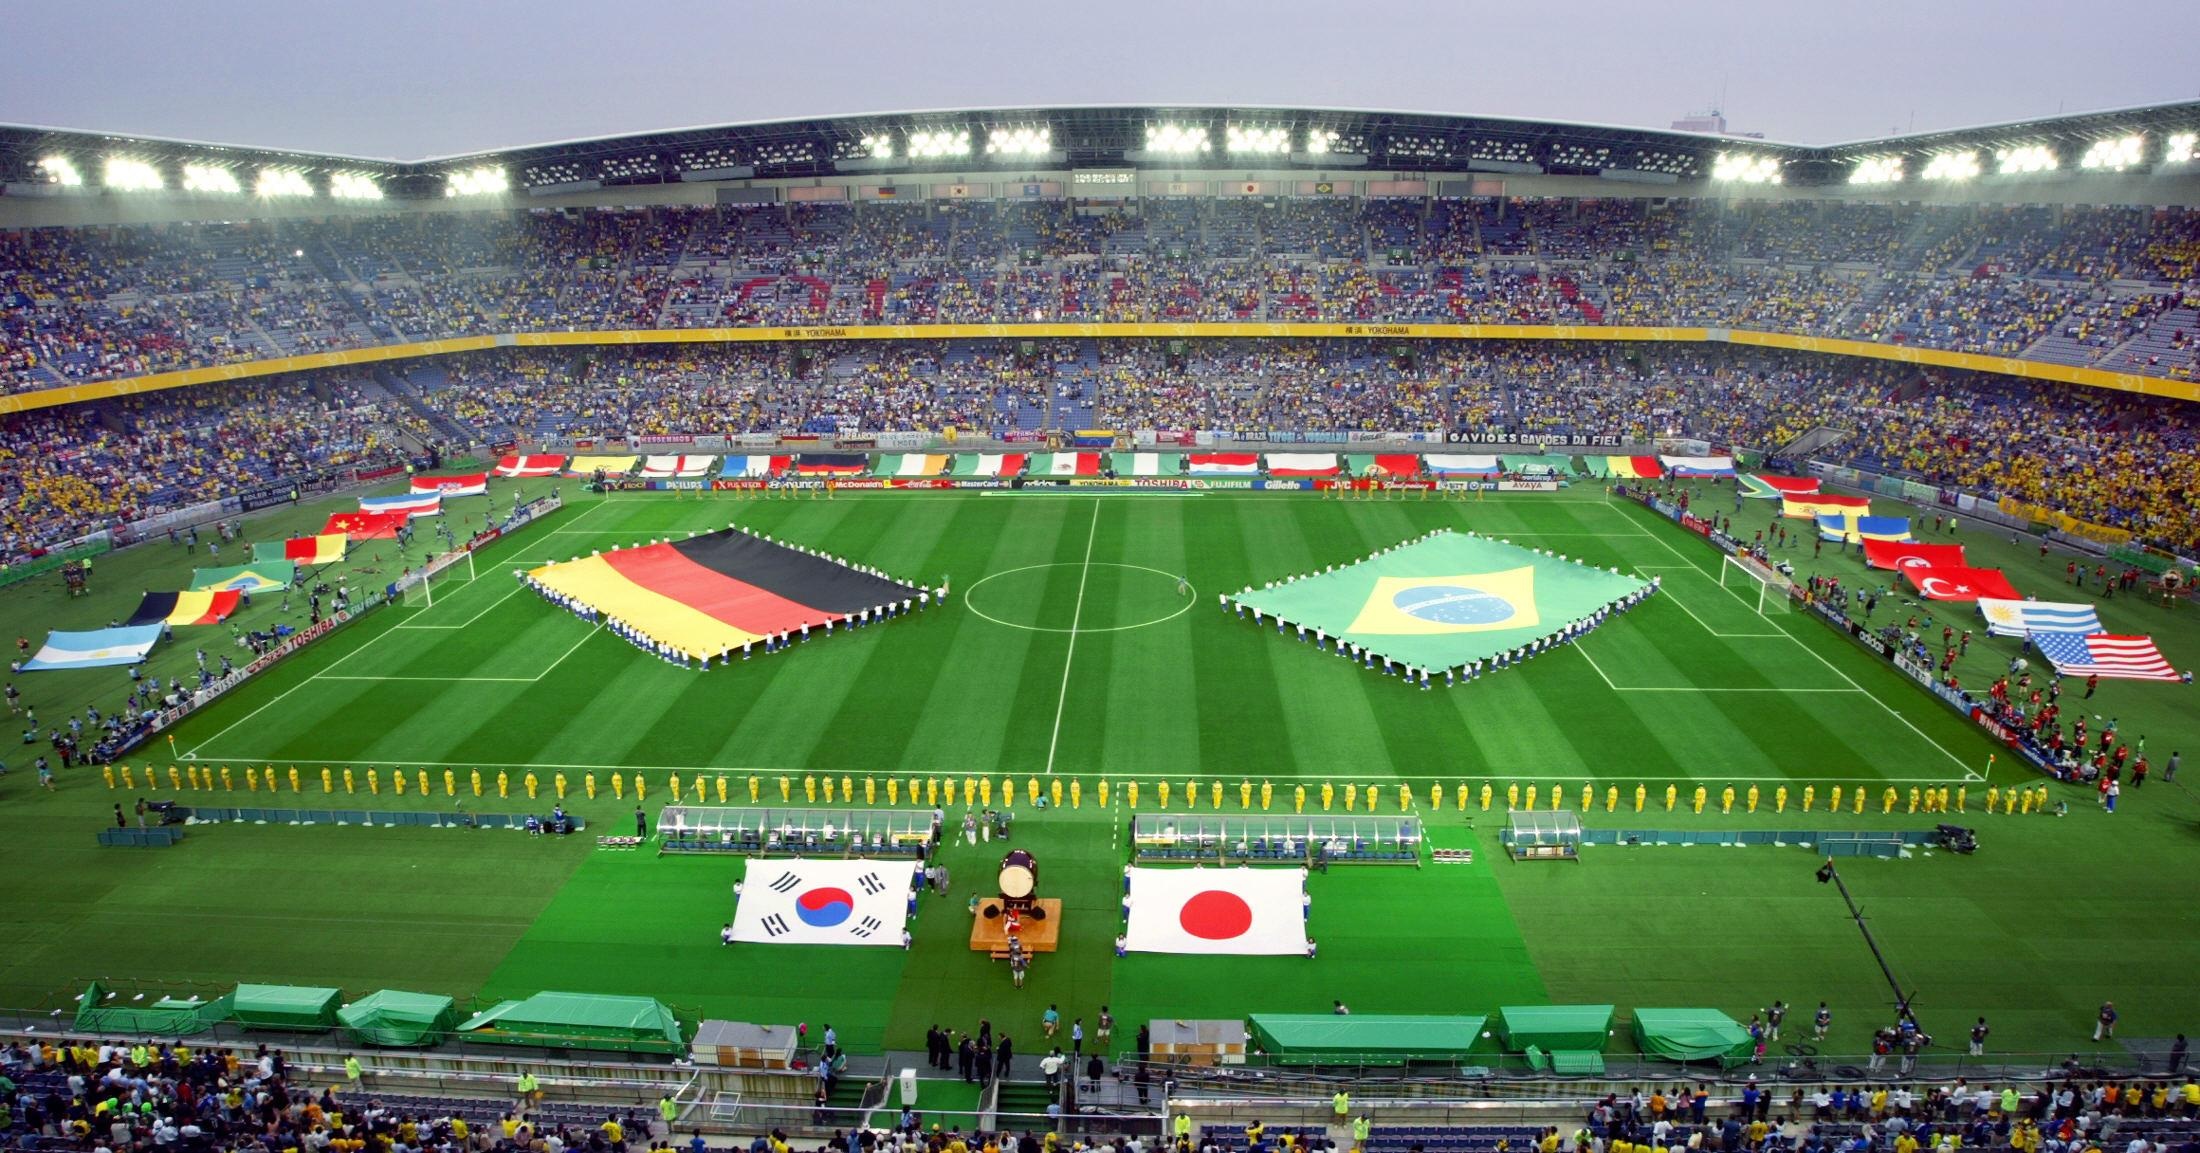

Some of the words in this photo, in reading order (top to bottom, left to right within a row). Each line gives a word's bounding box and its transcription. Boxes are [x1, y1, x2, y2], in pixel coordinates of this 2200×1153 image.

[806, 328, 847, 337] YOKOHAMA
[1368, 326, 1410, 335] YOKOHAMA
[1572, 435, 1587, 445] DA
[1592, 435, 1620, 446] FIEL
[836, 481, 884, 489] McDonald's
[1135, 480, 1188, 489] TOSHIBA
[1210, 481, 1252, 489] FUJIFILM
[1265, 480, 1300, 489] Gillette
[1331, 481, 1352, 489] JVC
[288, 618, 335, 651] TOSHIBA
[1858, 629, 1886, 654] adidas
